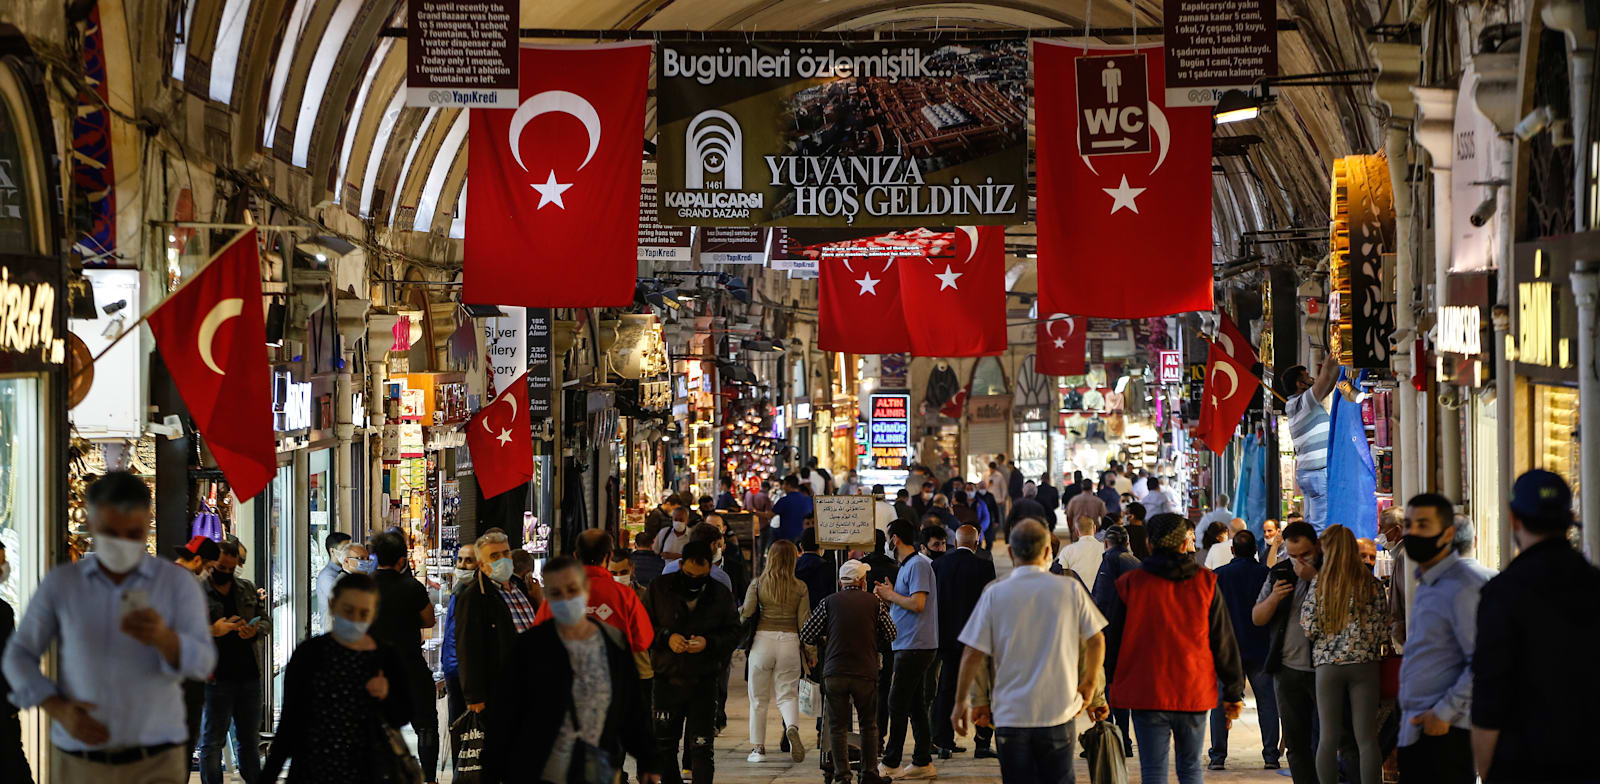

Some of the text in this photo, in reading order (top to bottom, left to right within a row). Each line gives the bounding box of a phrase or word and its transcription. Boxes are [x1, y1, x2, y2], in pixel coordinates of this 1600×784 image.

[424, 2, 504, 13] Up until recently the
[1238, 0, 1259, 10] yakın
[418, 11, 440, 20] Grand
[442, 12, 468, 20] Bazaar
[488, 12, 510, 21] home
[1210, 12, 1232, 20] kadar
[1234, 12, 1239, 20] 5
[436, 22, 473, 30] mosques,
[480, 22, 508, 31] school,
[430, 30, 469, 39] fountains,
[481, 31, 504, 40] wells,
[1222, 34, 1241, 43] sebil
[451, 39, 490, 48] dispenser
[1176, 47, 1210, 58] şadırvan
[422, 57, 445, 65] Today
[448, 58, 464, 66] only
[471, 59, 504, 67] mosque,
[664, 47, 952, 84] Bugünleri özlemiştik...
[1180, 59, 1205, 69] Bugün
[478, 66, 510, 74] ablution
[1194, 69, 1227, 80] şadırvan
[480, 75, 496, 83] left.
[1084, 106, 1144, 135] WC
[764, 155, 925, 185] YUVANIZA
[706, 181, 722, 190] 1461
[794, 177, 1017, 224] HOŞ GELDİNİZ
[678, 208, 750, 218] GRAND BAZAAR
[485, 326, 517, 337] Siver
[876, 398, 904, 408] ALTIN
[873, 408, 906, 418] ALINIR
[872, 422, 907, 433] GÜMÜŞ
[873, 434, 906, 443] ALINIR
